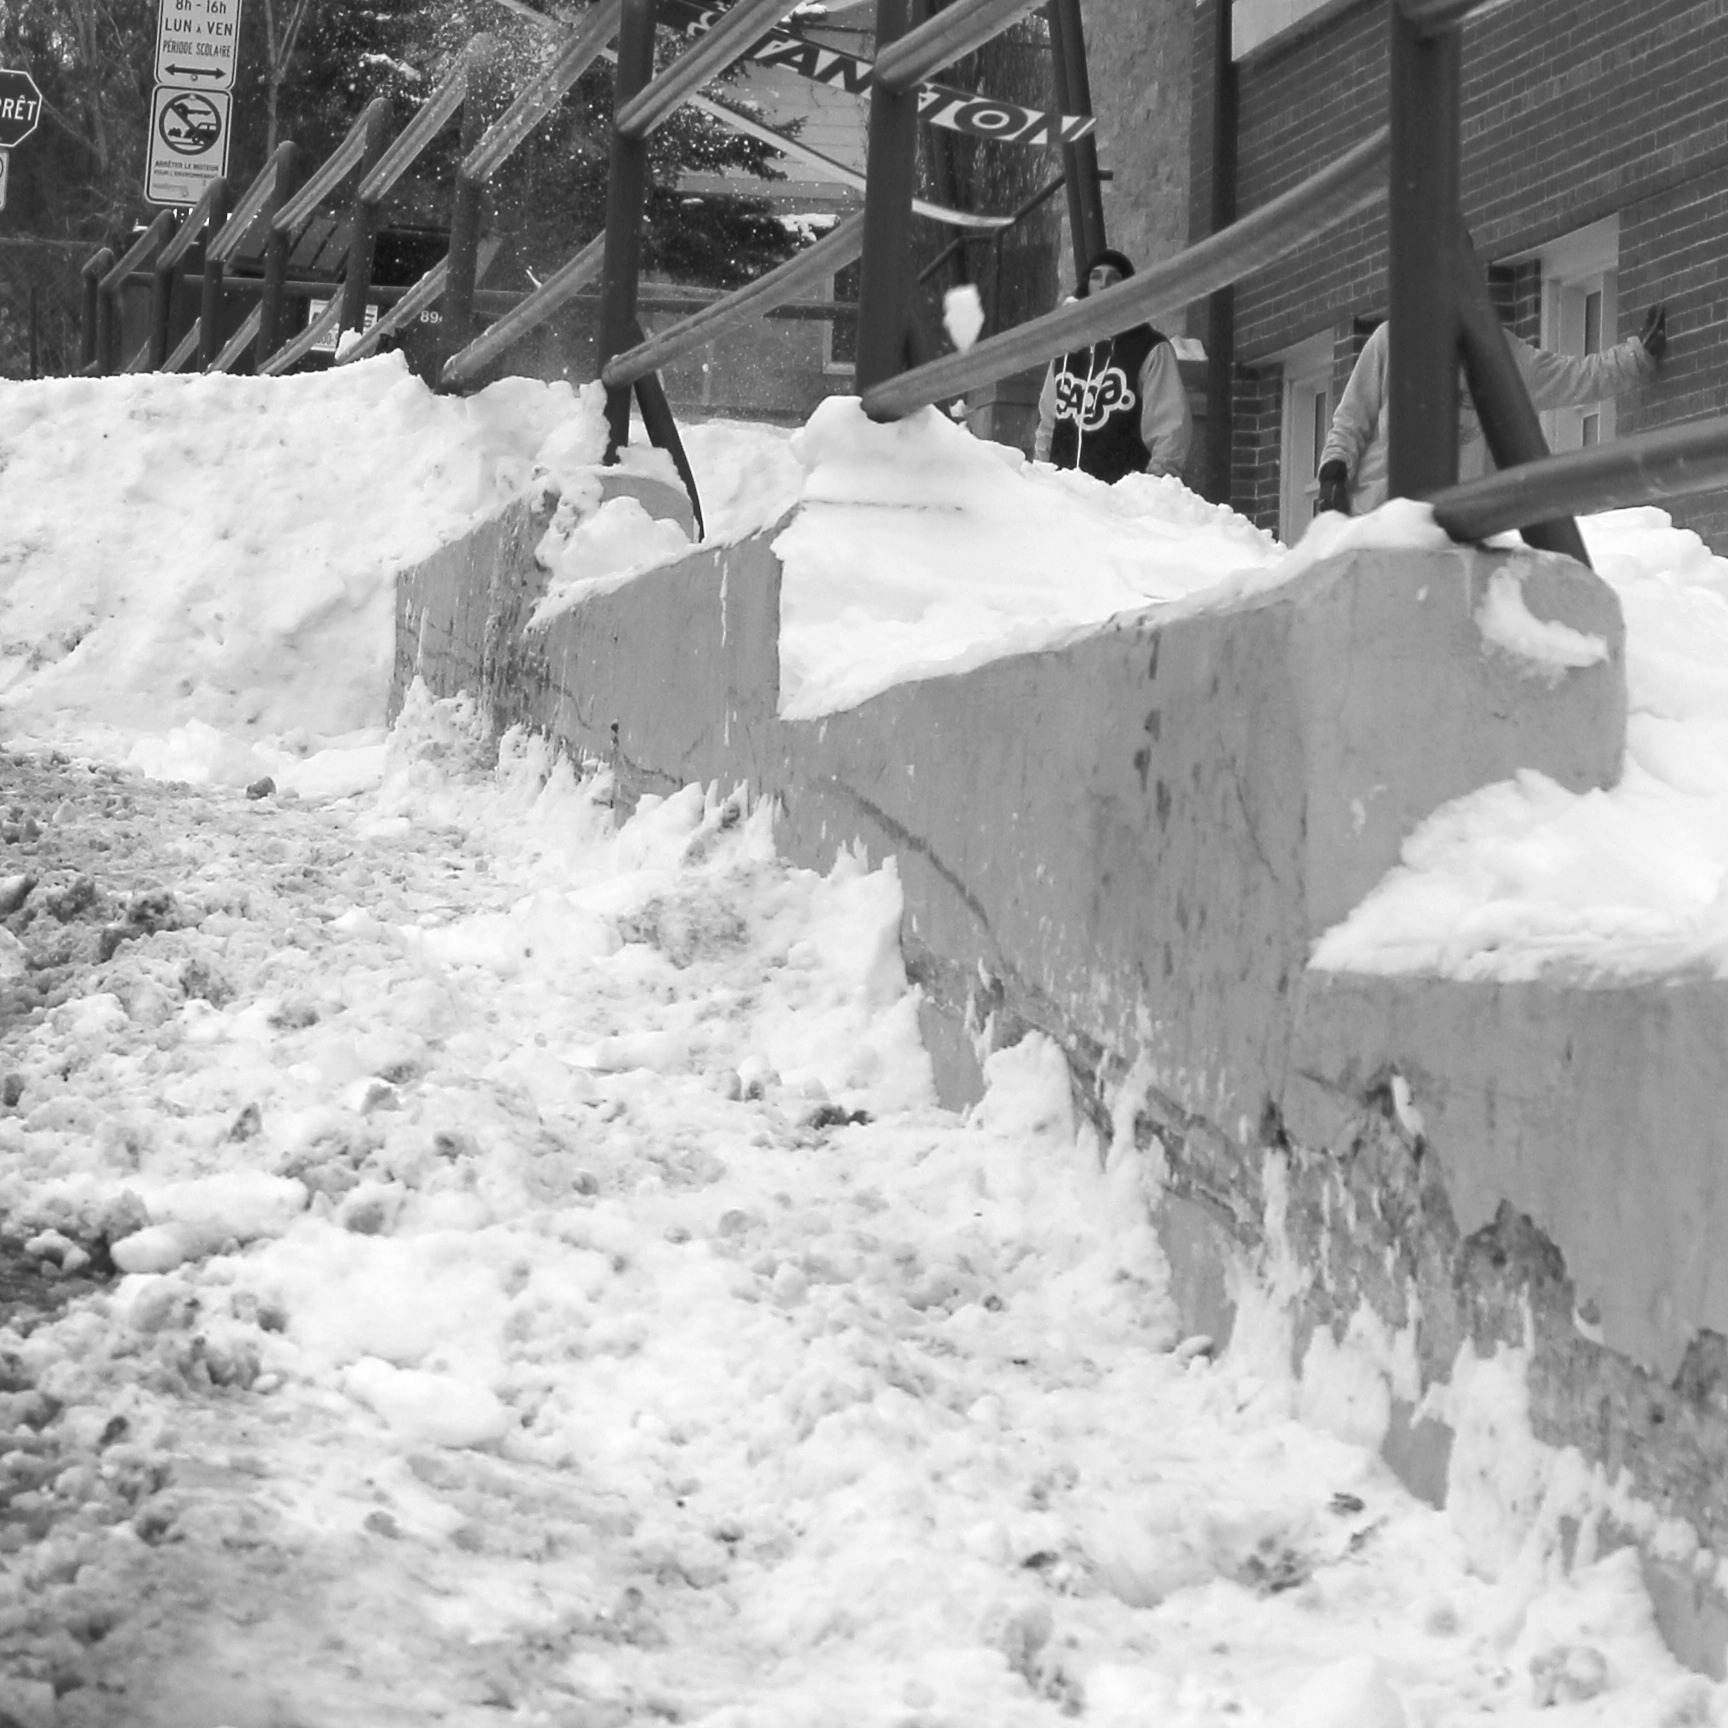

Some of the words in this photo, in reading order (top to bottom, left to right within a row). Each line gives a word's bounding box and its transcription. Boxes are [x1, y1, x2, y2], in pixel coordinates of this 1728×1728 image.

[206, 0, 227, 14] 16h
[164, 17, 192, 33] LUN
[206, 21, 233, 36] VEN
[196, 42, 232, 58] SCOLAIRE
